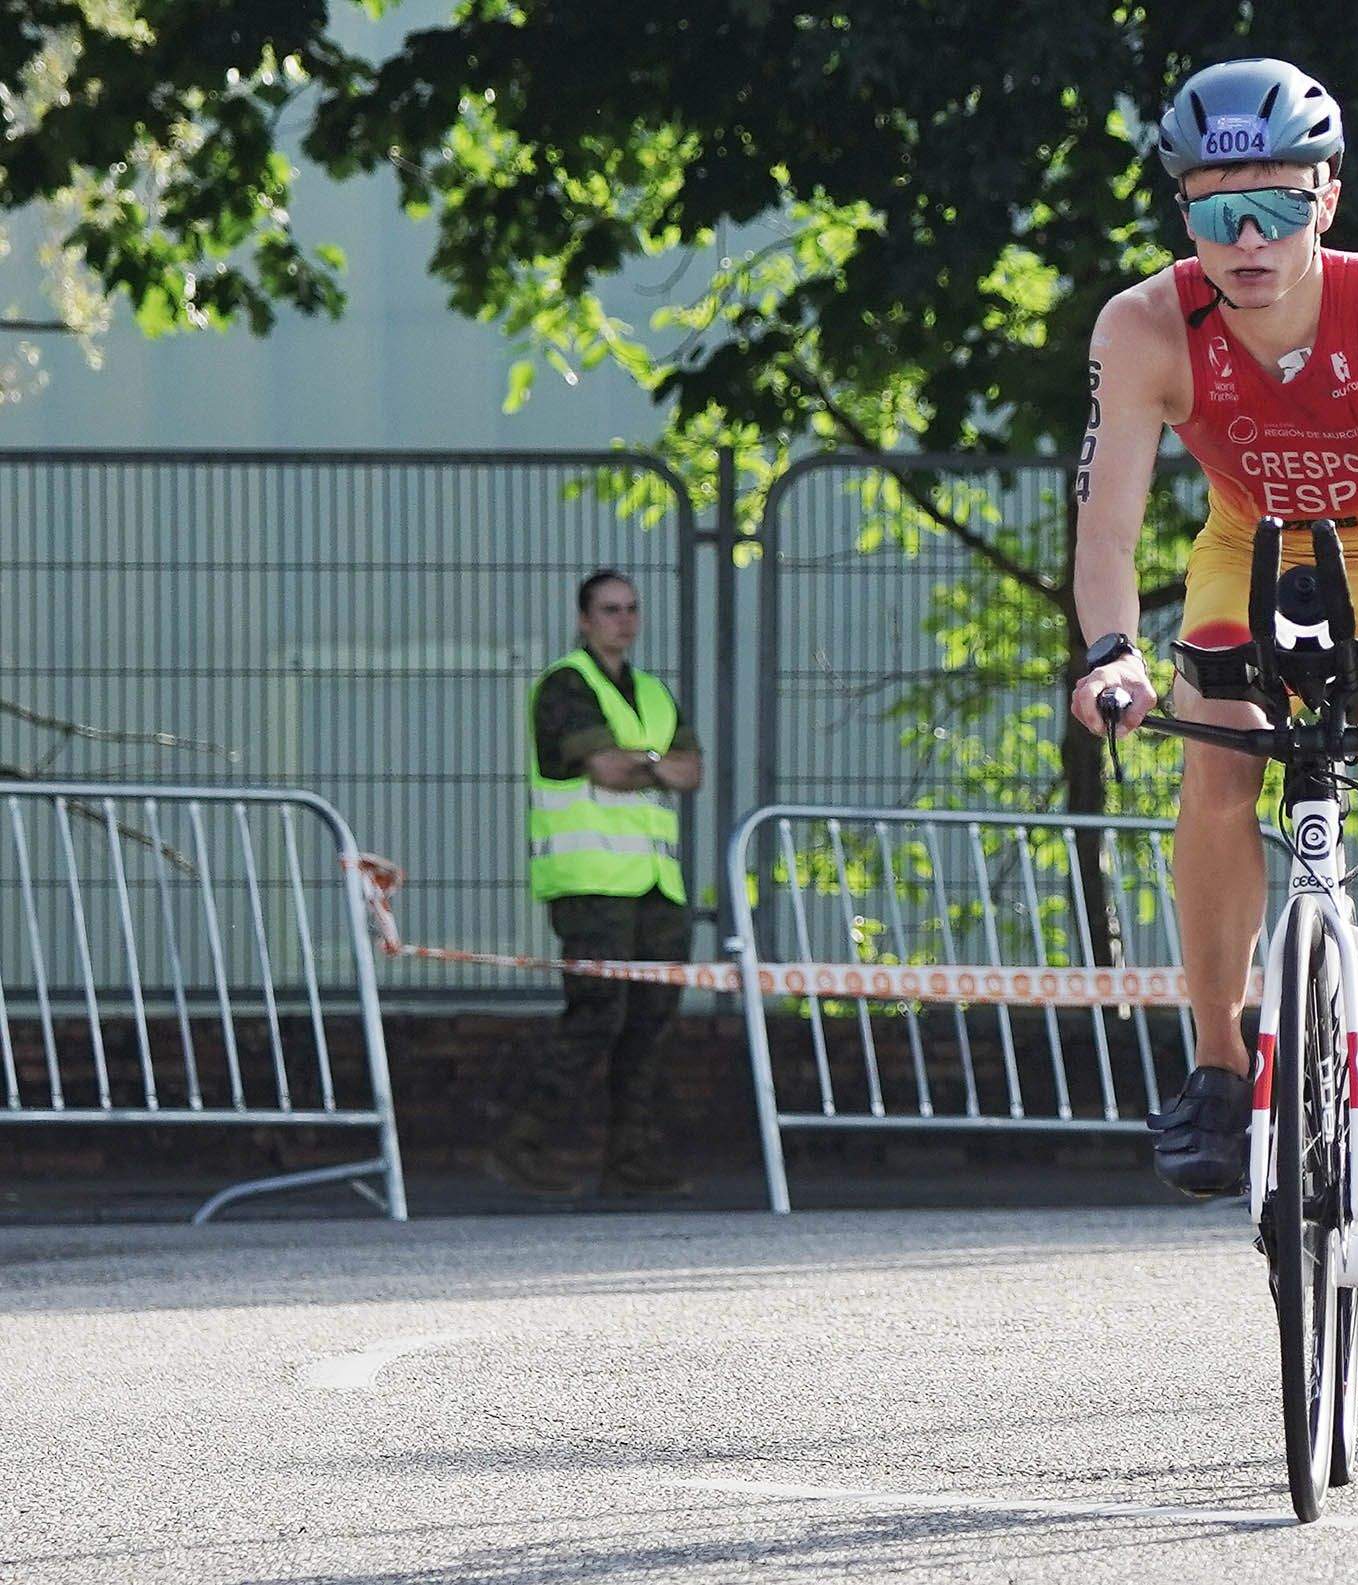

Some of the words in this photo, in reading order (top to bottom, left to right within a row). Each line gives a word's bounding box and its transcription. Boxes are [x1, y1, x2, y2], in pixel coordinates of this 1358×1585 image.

[1206, 130, 1265, 154] 6004
[1077, 360, 1102, 503] 6004
[1306, 431, 1321, 439] DE
[1263, 480, 1357, 514] ESP
